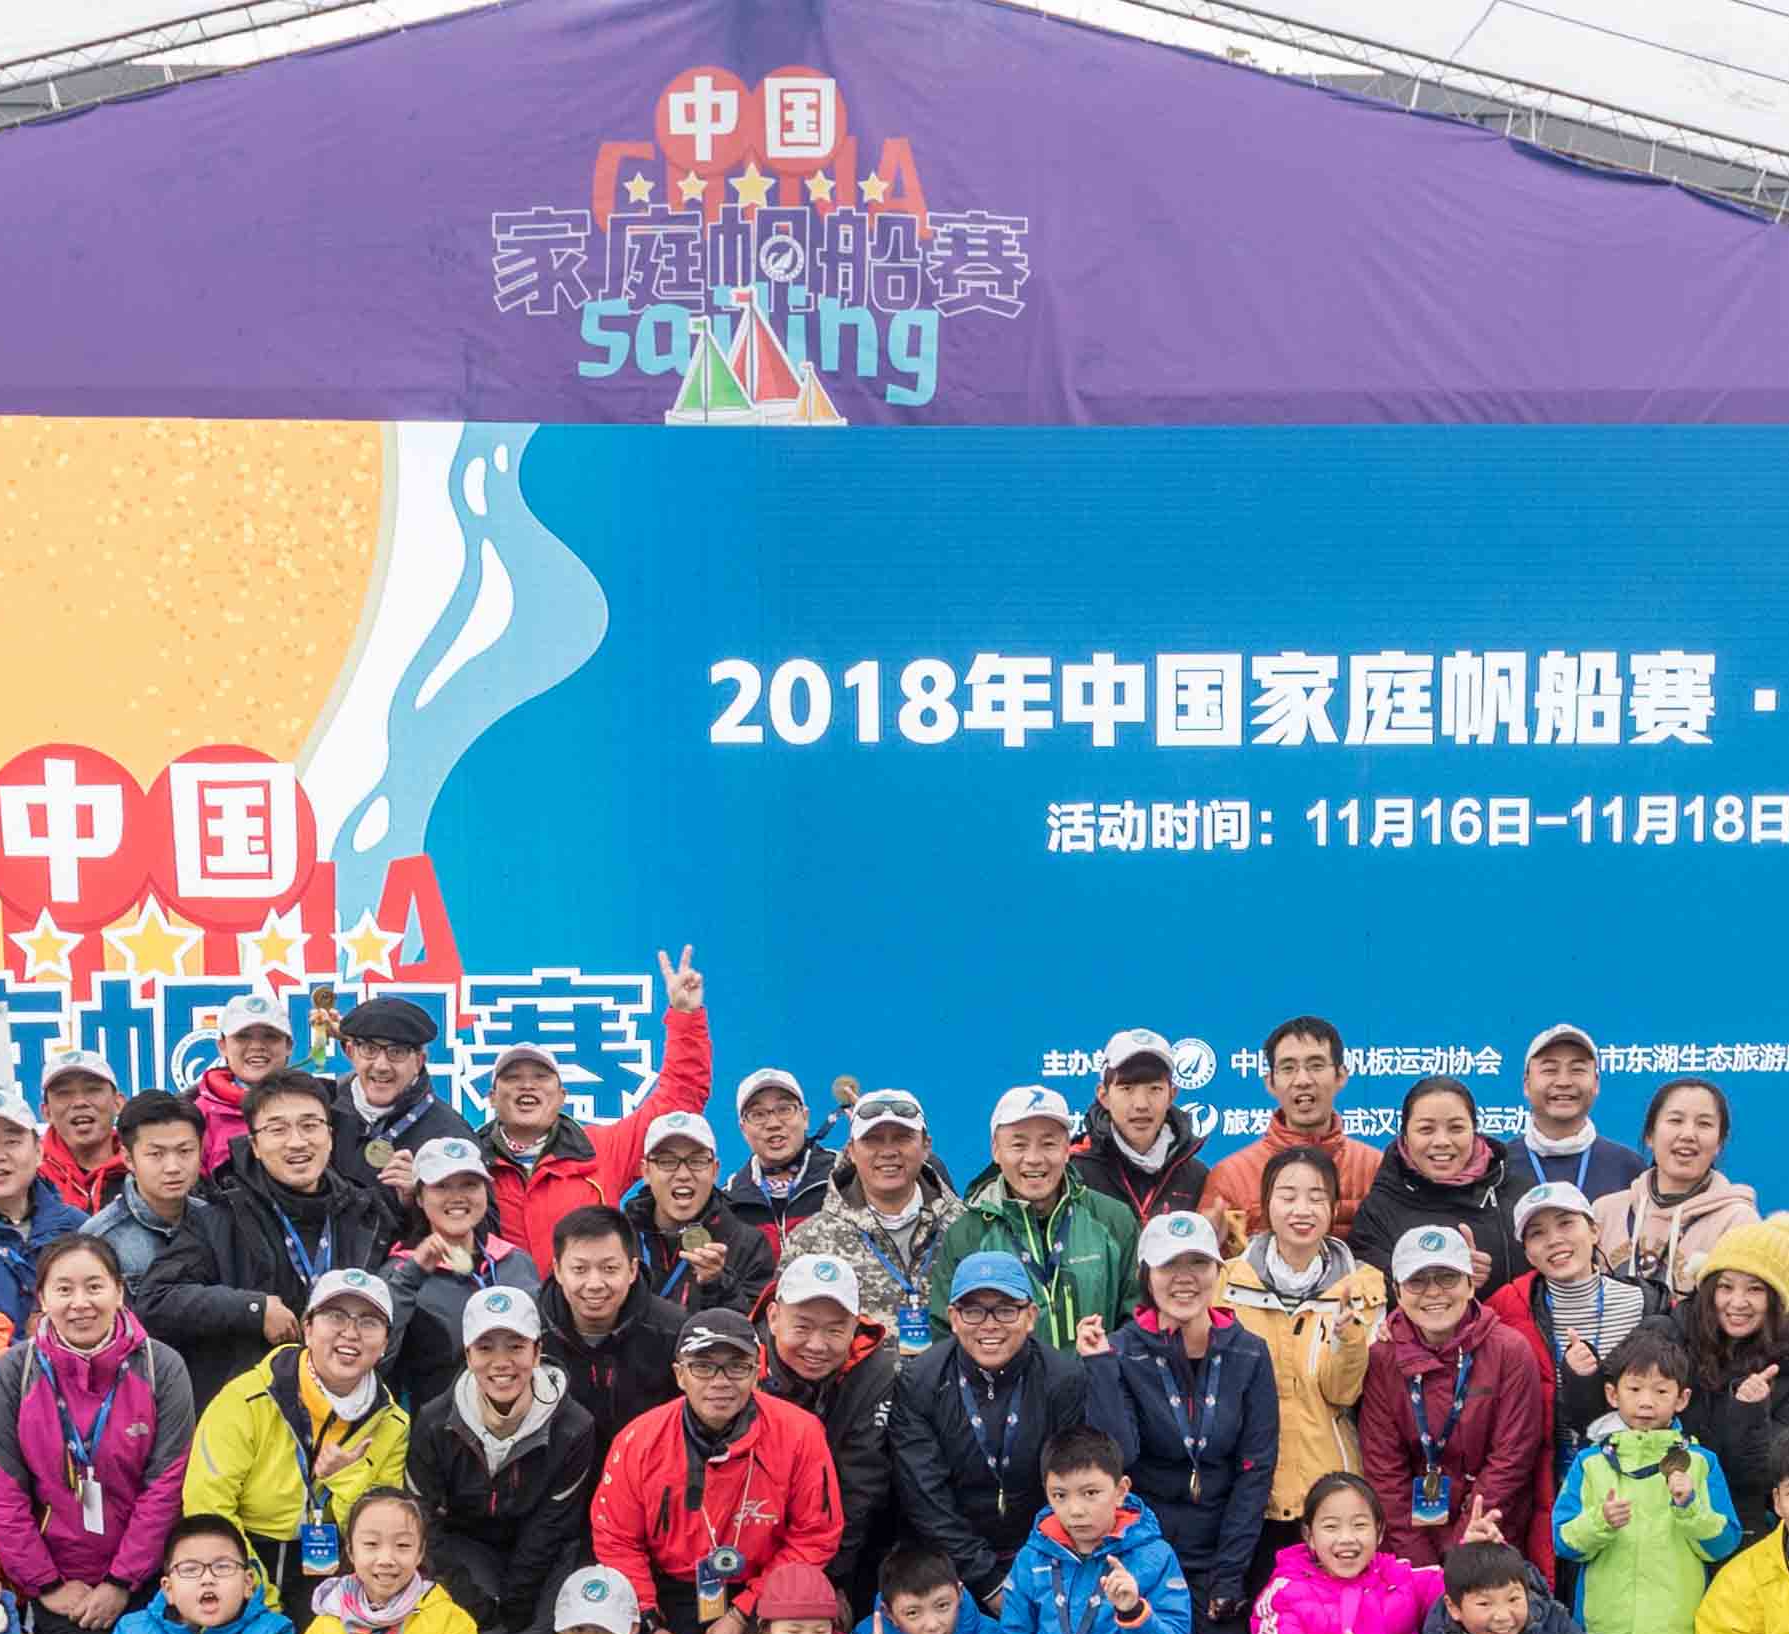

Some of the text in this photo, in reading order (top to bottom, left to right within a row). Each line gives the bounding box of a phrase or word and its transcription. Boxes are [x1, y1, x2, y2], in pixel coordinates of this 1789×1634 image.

[668, 75, 837, 162] 中国
[492, 205, 1031, 319] 家庭帆船赛
